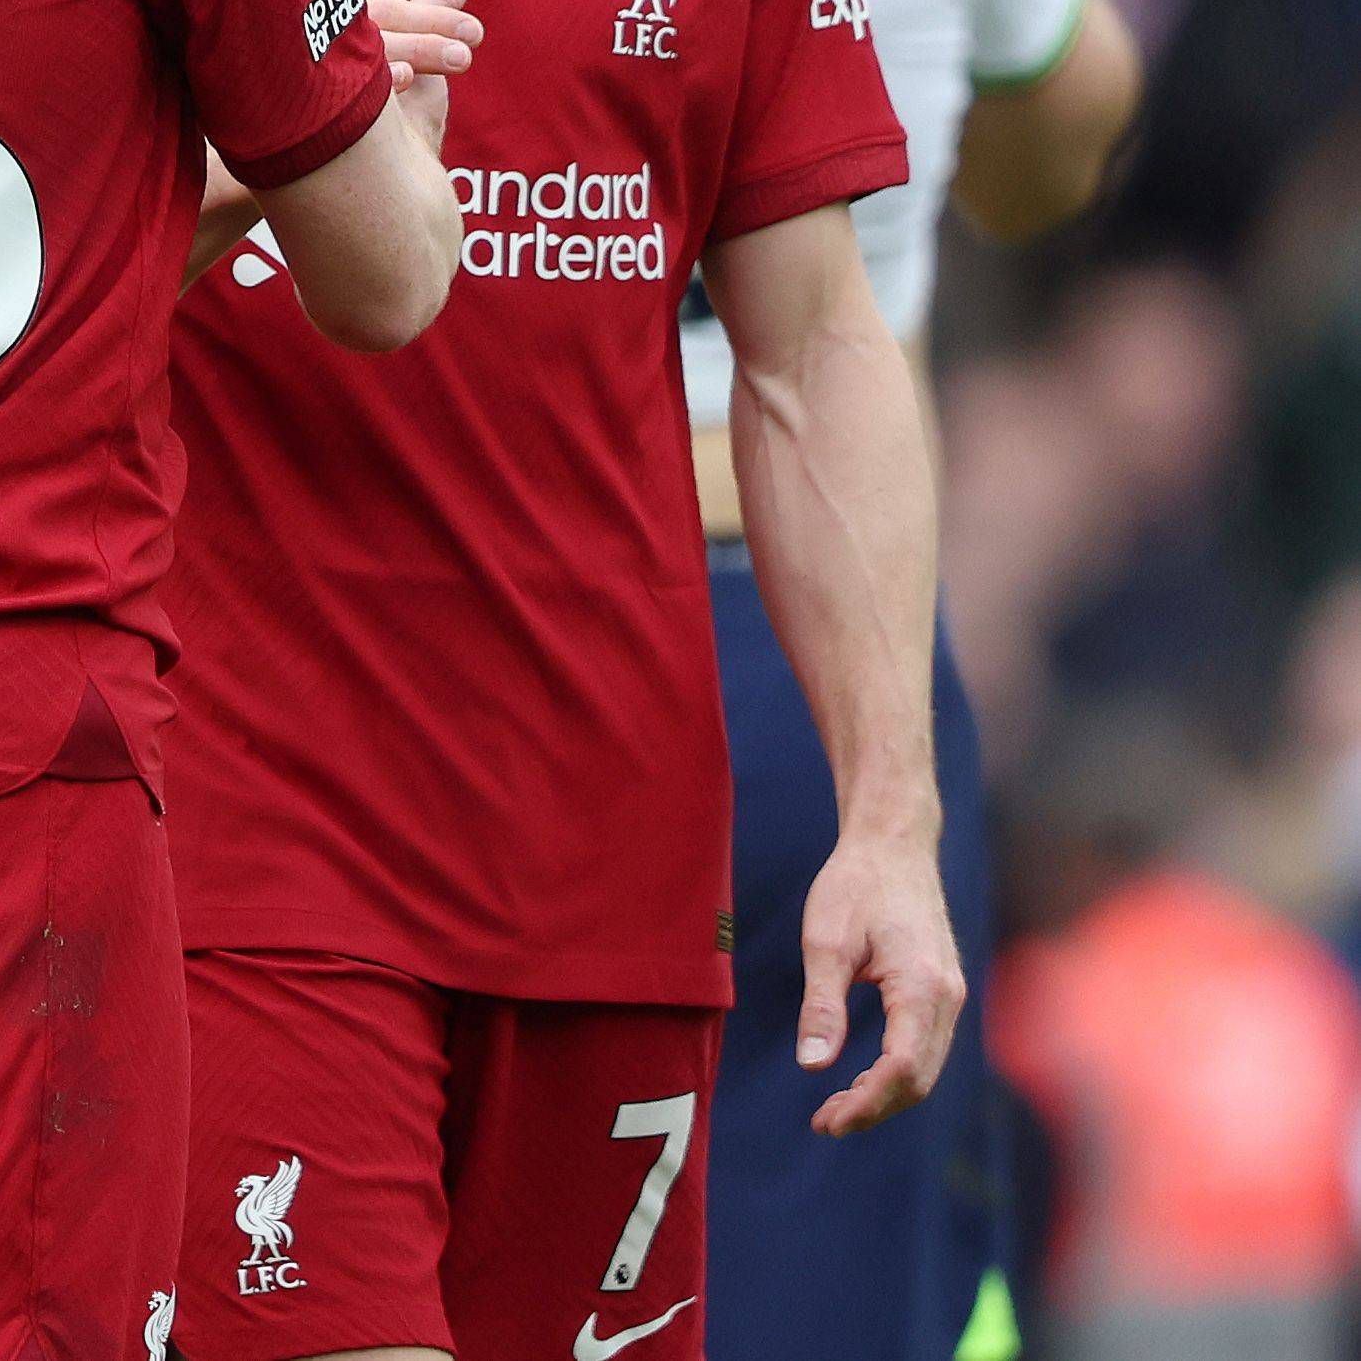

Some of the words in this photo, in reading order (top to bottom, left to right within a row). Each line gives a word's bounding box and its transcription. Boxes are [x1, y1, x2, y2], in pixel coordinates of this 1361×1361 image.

[304, 0, 326, 40] No
[612, 20, 678, 59] L.F.C.
[446, 162, 650, 221] andard
[460, 221, 666, 281] artered
[599, 1092, 696, 1292] 7
[237, 1262, 308, 1295] L.F.C.
